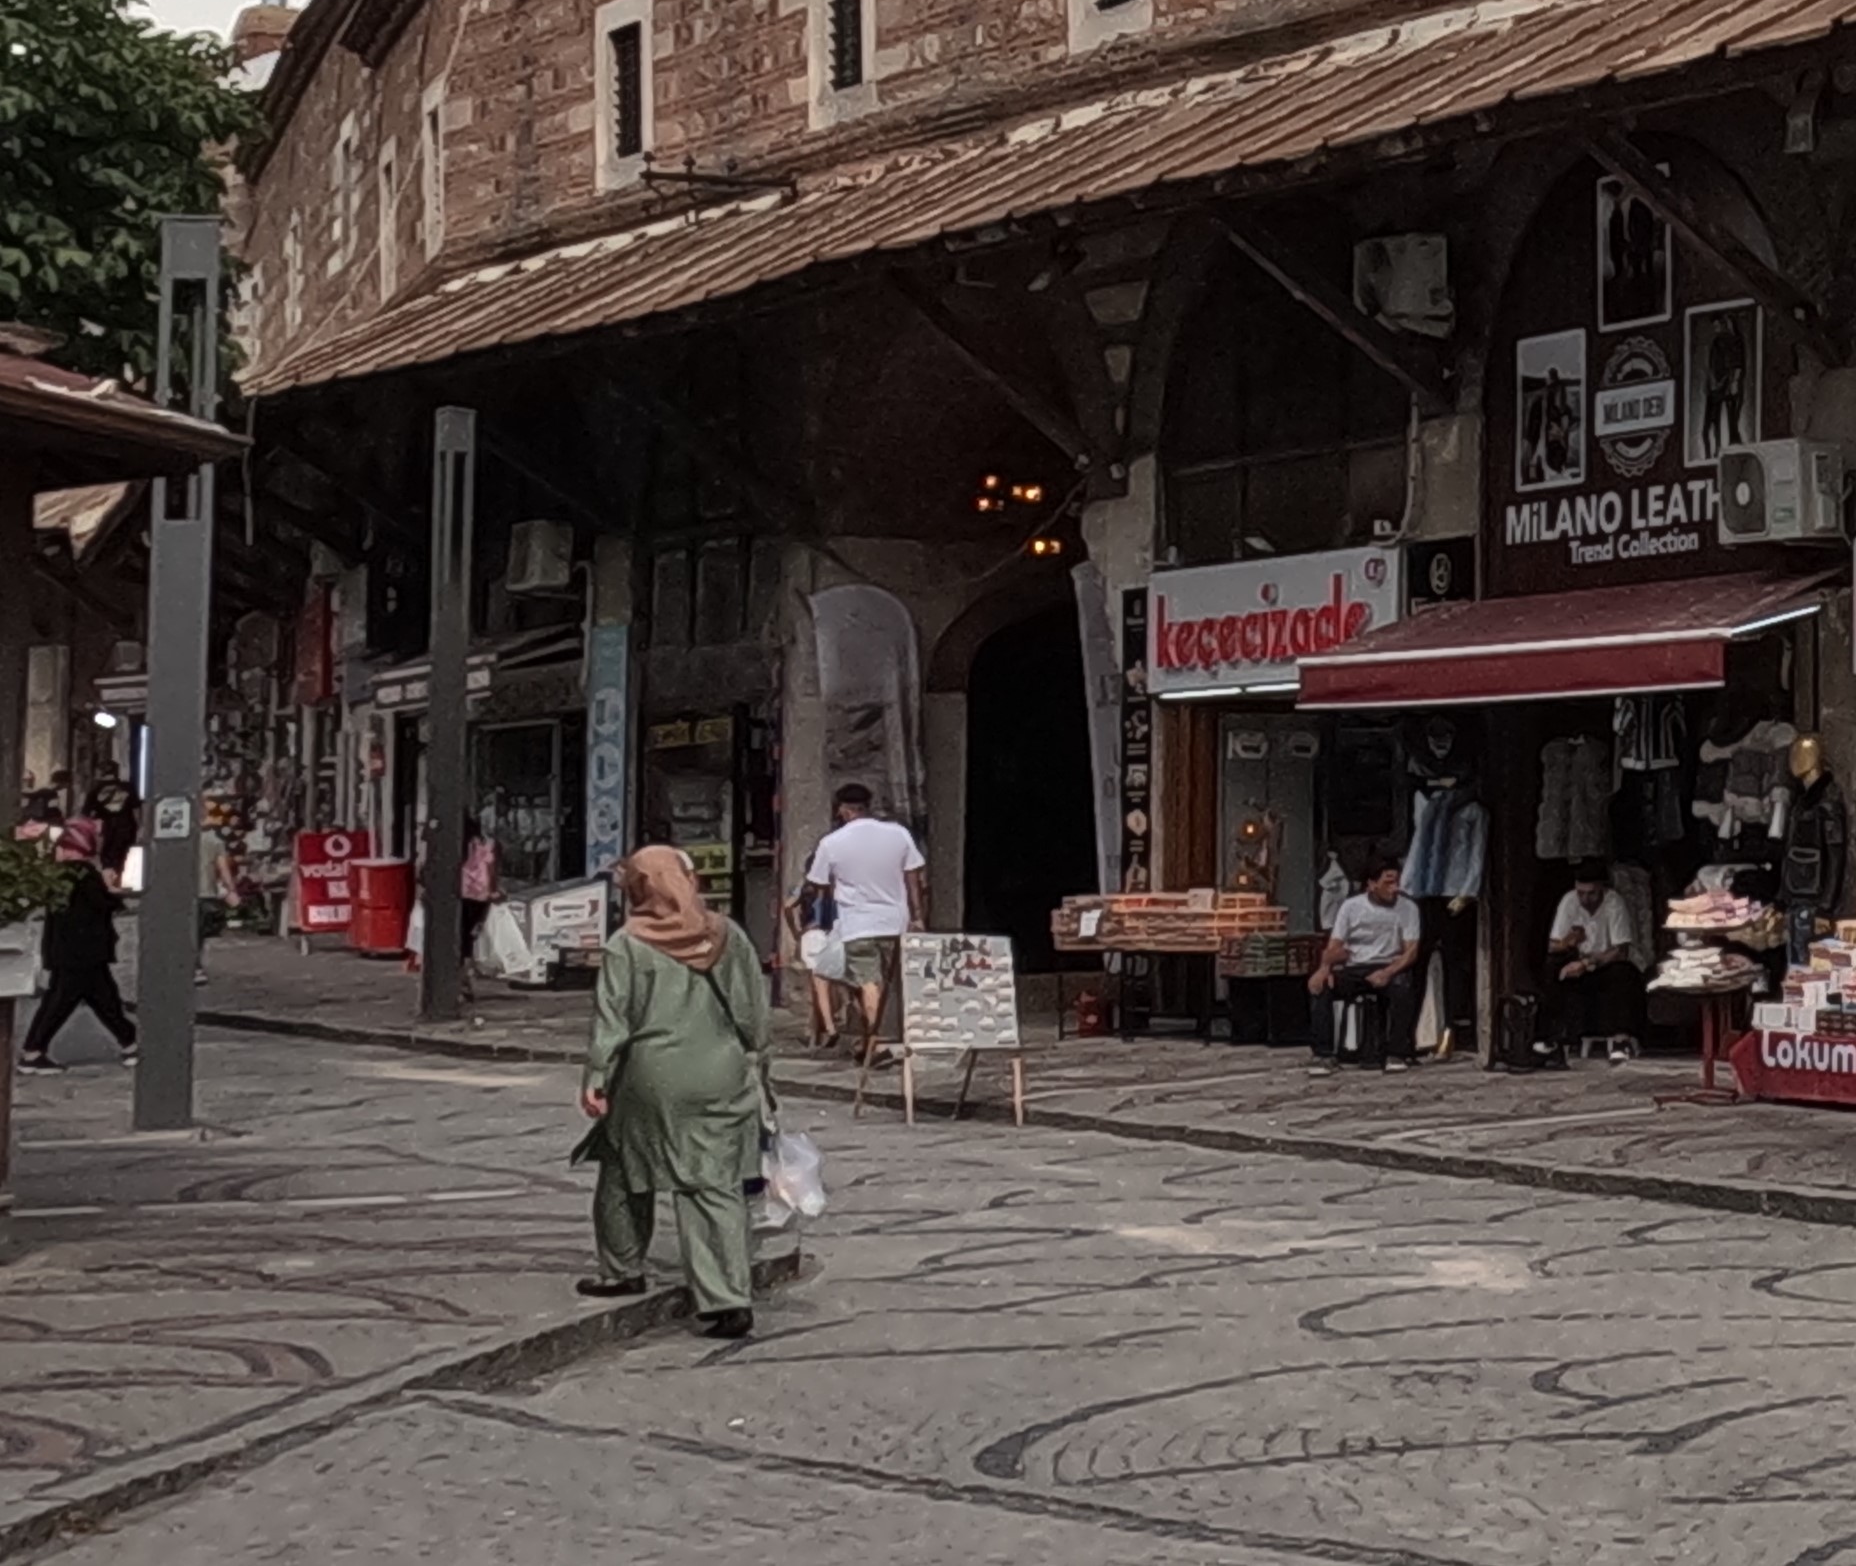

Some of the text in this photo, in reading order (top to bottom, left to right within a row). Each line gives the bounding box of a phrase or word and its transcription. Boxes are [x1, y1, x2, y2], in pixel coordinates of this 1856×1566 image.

[1631, 478, 1719, 530] LEATH
[1568, 527, 1699, 565] Trend Collection
[299, 860, 350, 878] vodaf
